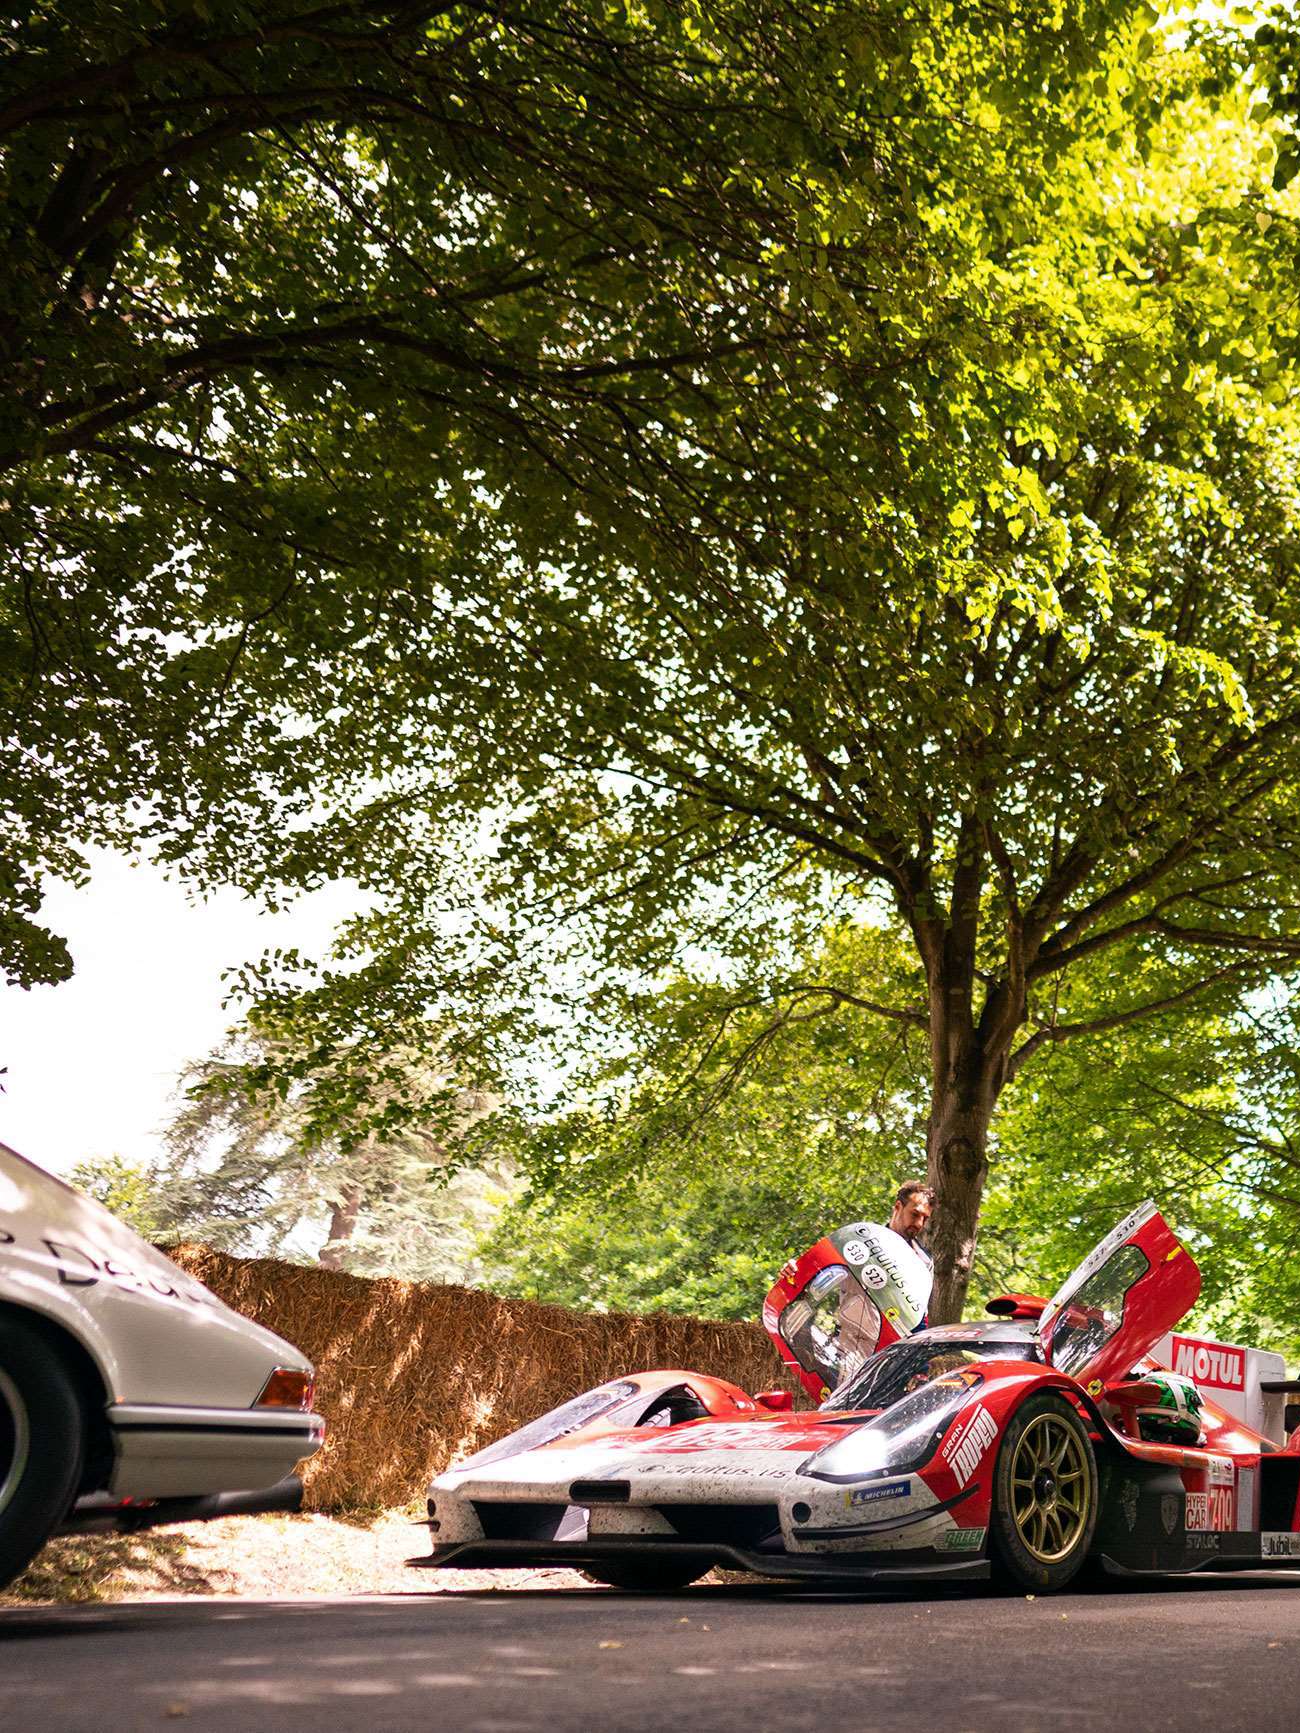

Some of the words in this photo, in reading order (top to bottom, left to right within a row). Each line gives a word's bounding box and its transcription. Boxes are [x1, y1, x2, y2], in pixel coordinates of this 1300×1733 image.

[847, 1244, 865, 1261] 530
[865, 1268, 884, 1287] 527
[1175, 1343, 1243, 1385] MOTUL
[942, 1423, 963, 1458] GRAN
[864, 1485, 905, 1499] MICHELIN
[1186, 1509, 1206, 1529] CAR
